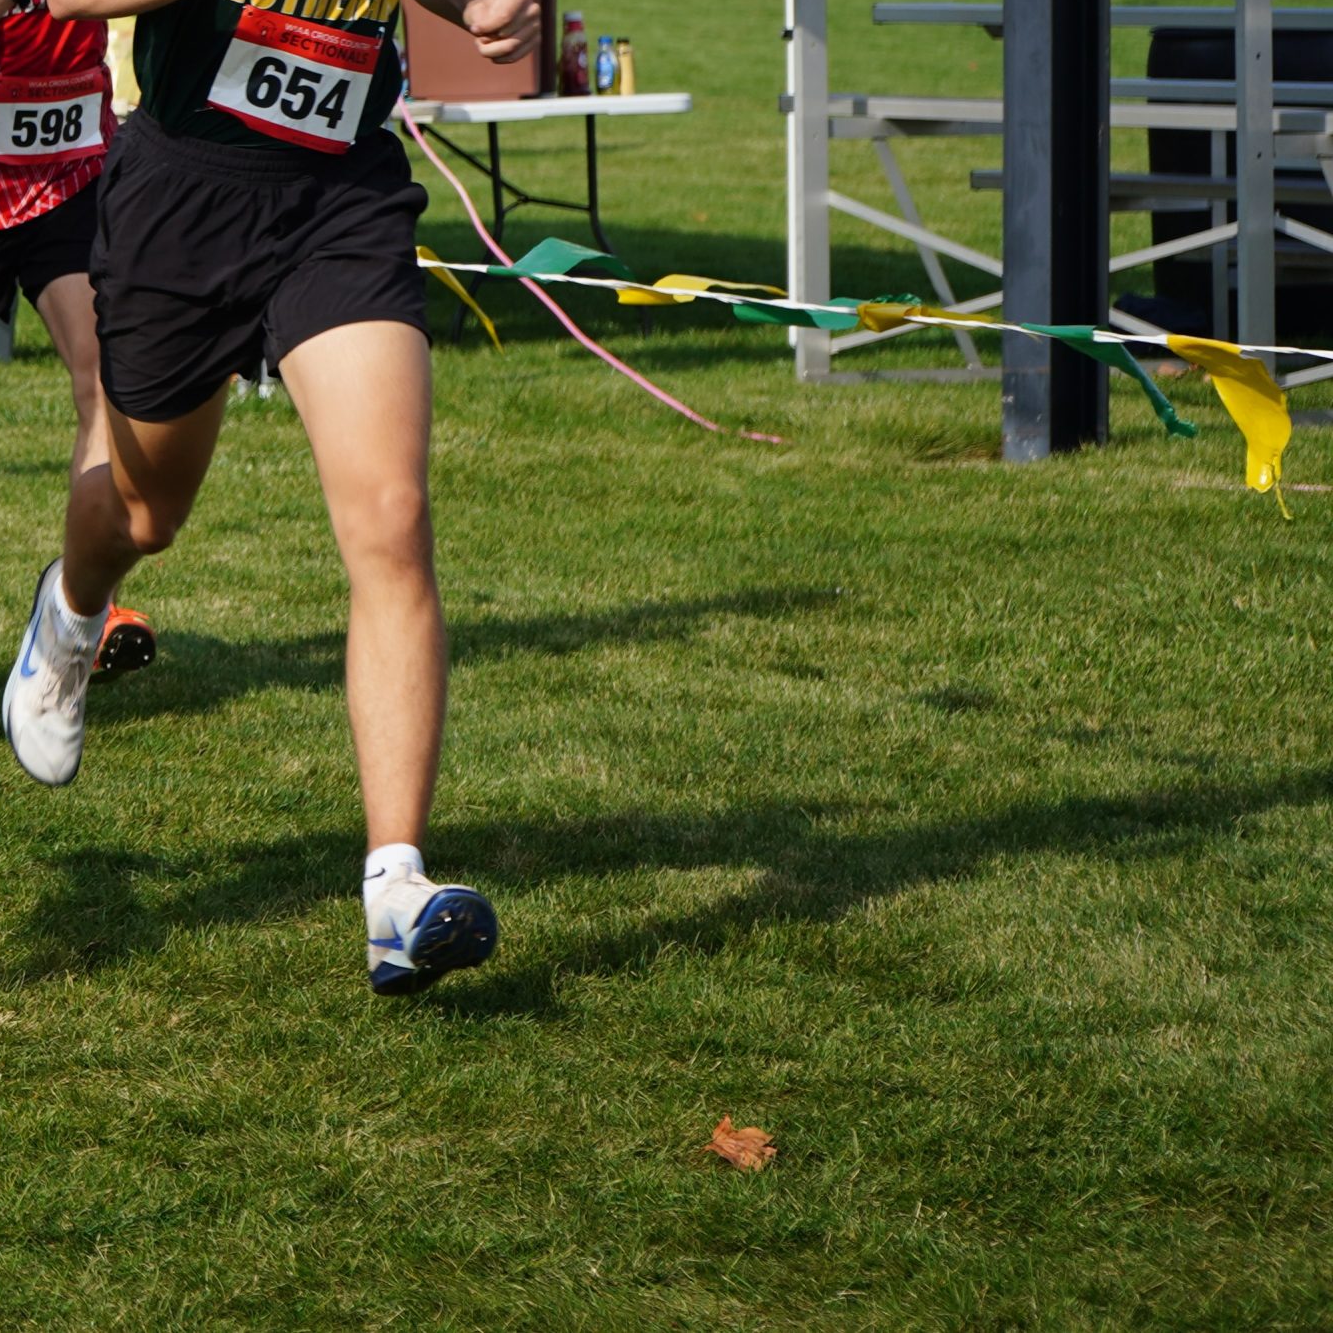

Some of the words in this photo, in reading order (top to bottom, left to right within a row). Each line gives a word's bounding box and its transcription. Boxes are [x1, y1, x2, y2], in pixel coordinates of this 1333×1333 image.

[279, 30, 371, 66] SECTIONALS
[310, 29, 341, 45] CROSS
[245, 56, 352, 130] 654
[11, 103, 84, 148] 598
